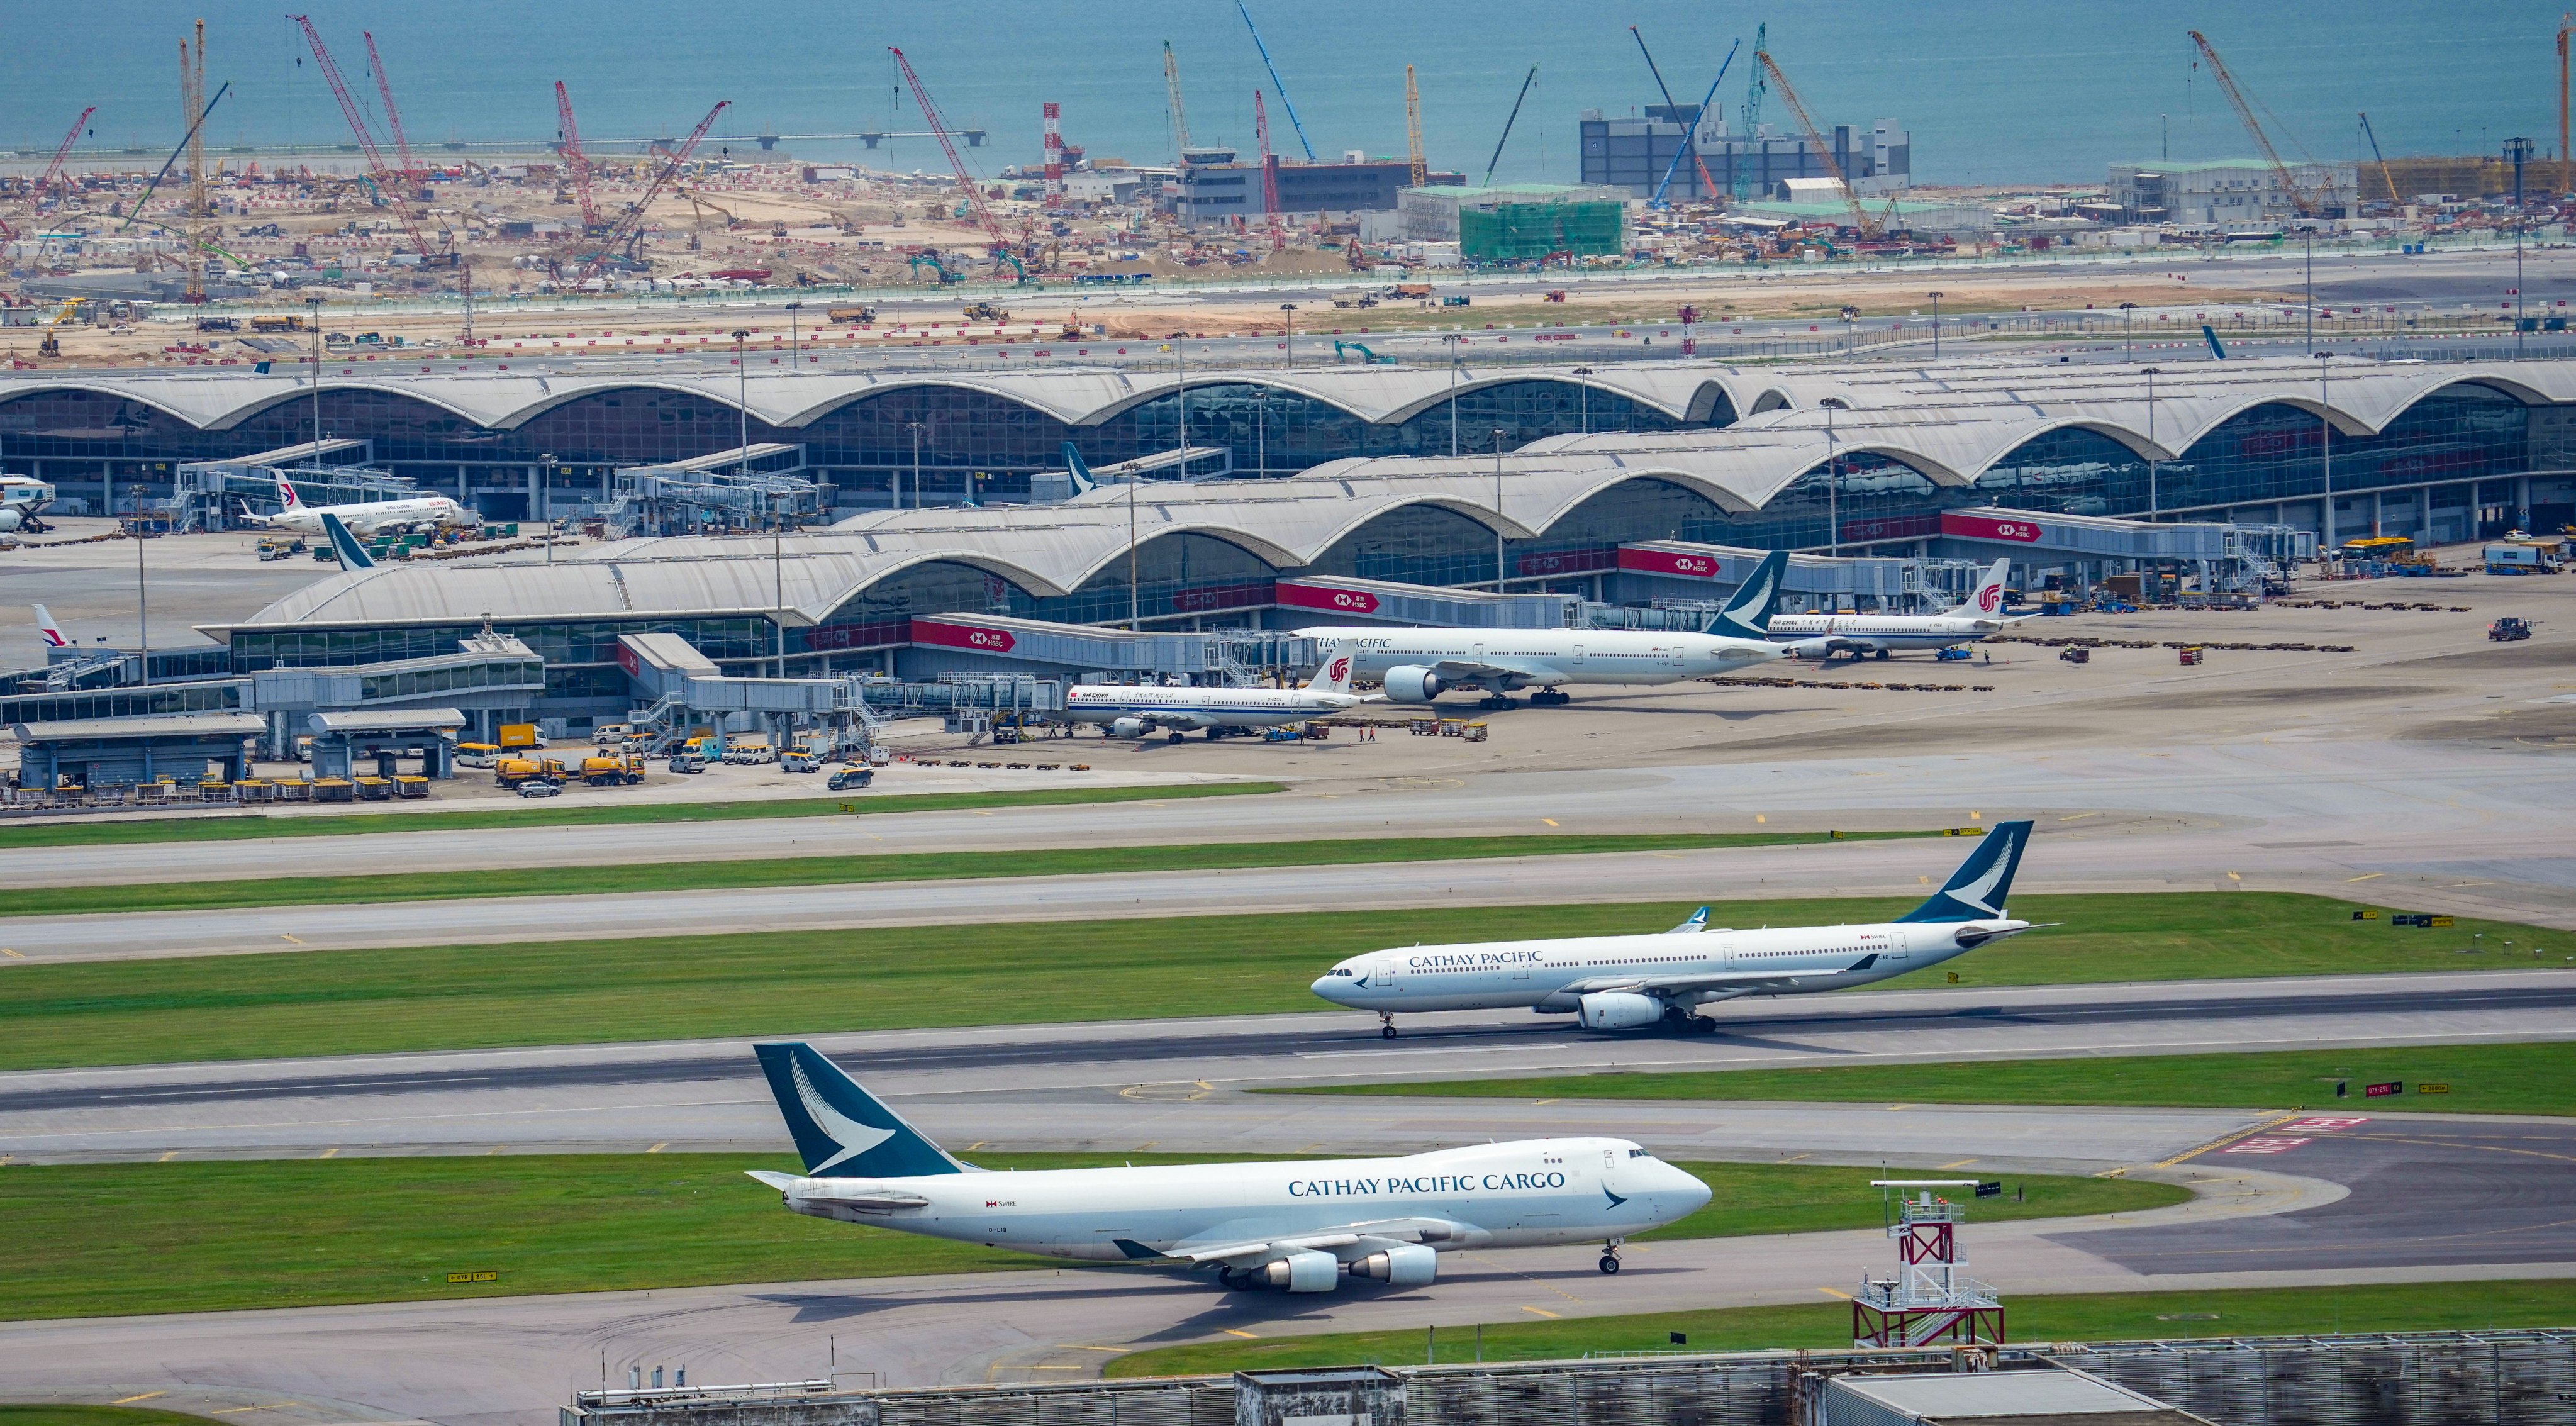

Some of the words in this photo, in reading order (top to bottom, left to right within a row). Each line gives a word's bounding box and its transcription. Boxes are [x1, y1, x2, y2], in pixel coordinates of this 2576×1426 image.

[1409, 954, 1475, 967] CATHAY
[1481, 951, 1544, 964] PACIFIC
[2368, 1086, 2389, 1094] 07R-25L
[1288, 1179, 1381, 1196] CATHAY
[1388, 1175, 1476, 1194] PACIFIC
[1483, 1172, 1565, 1190] CARGO
